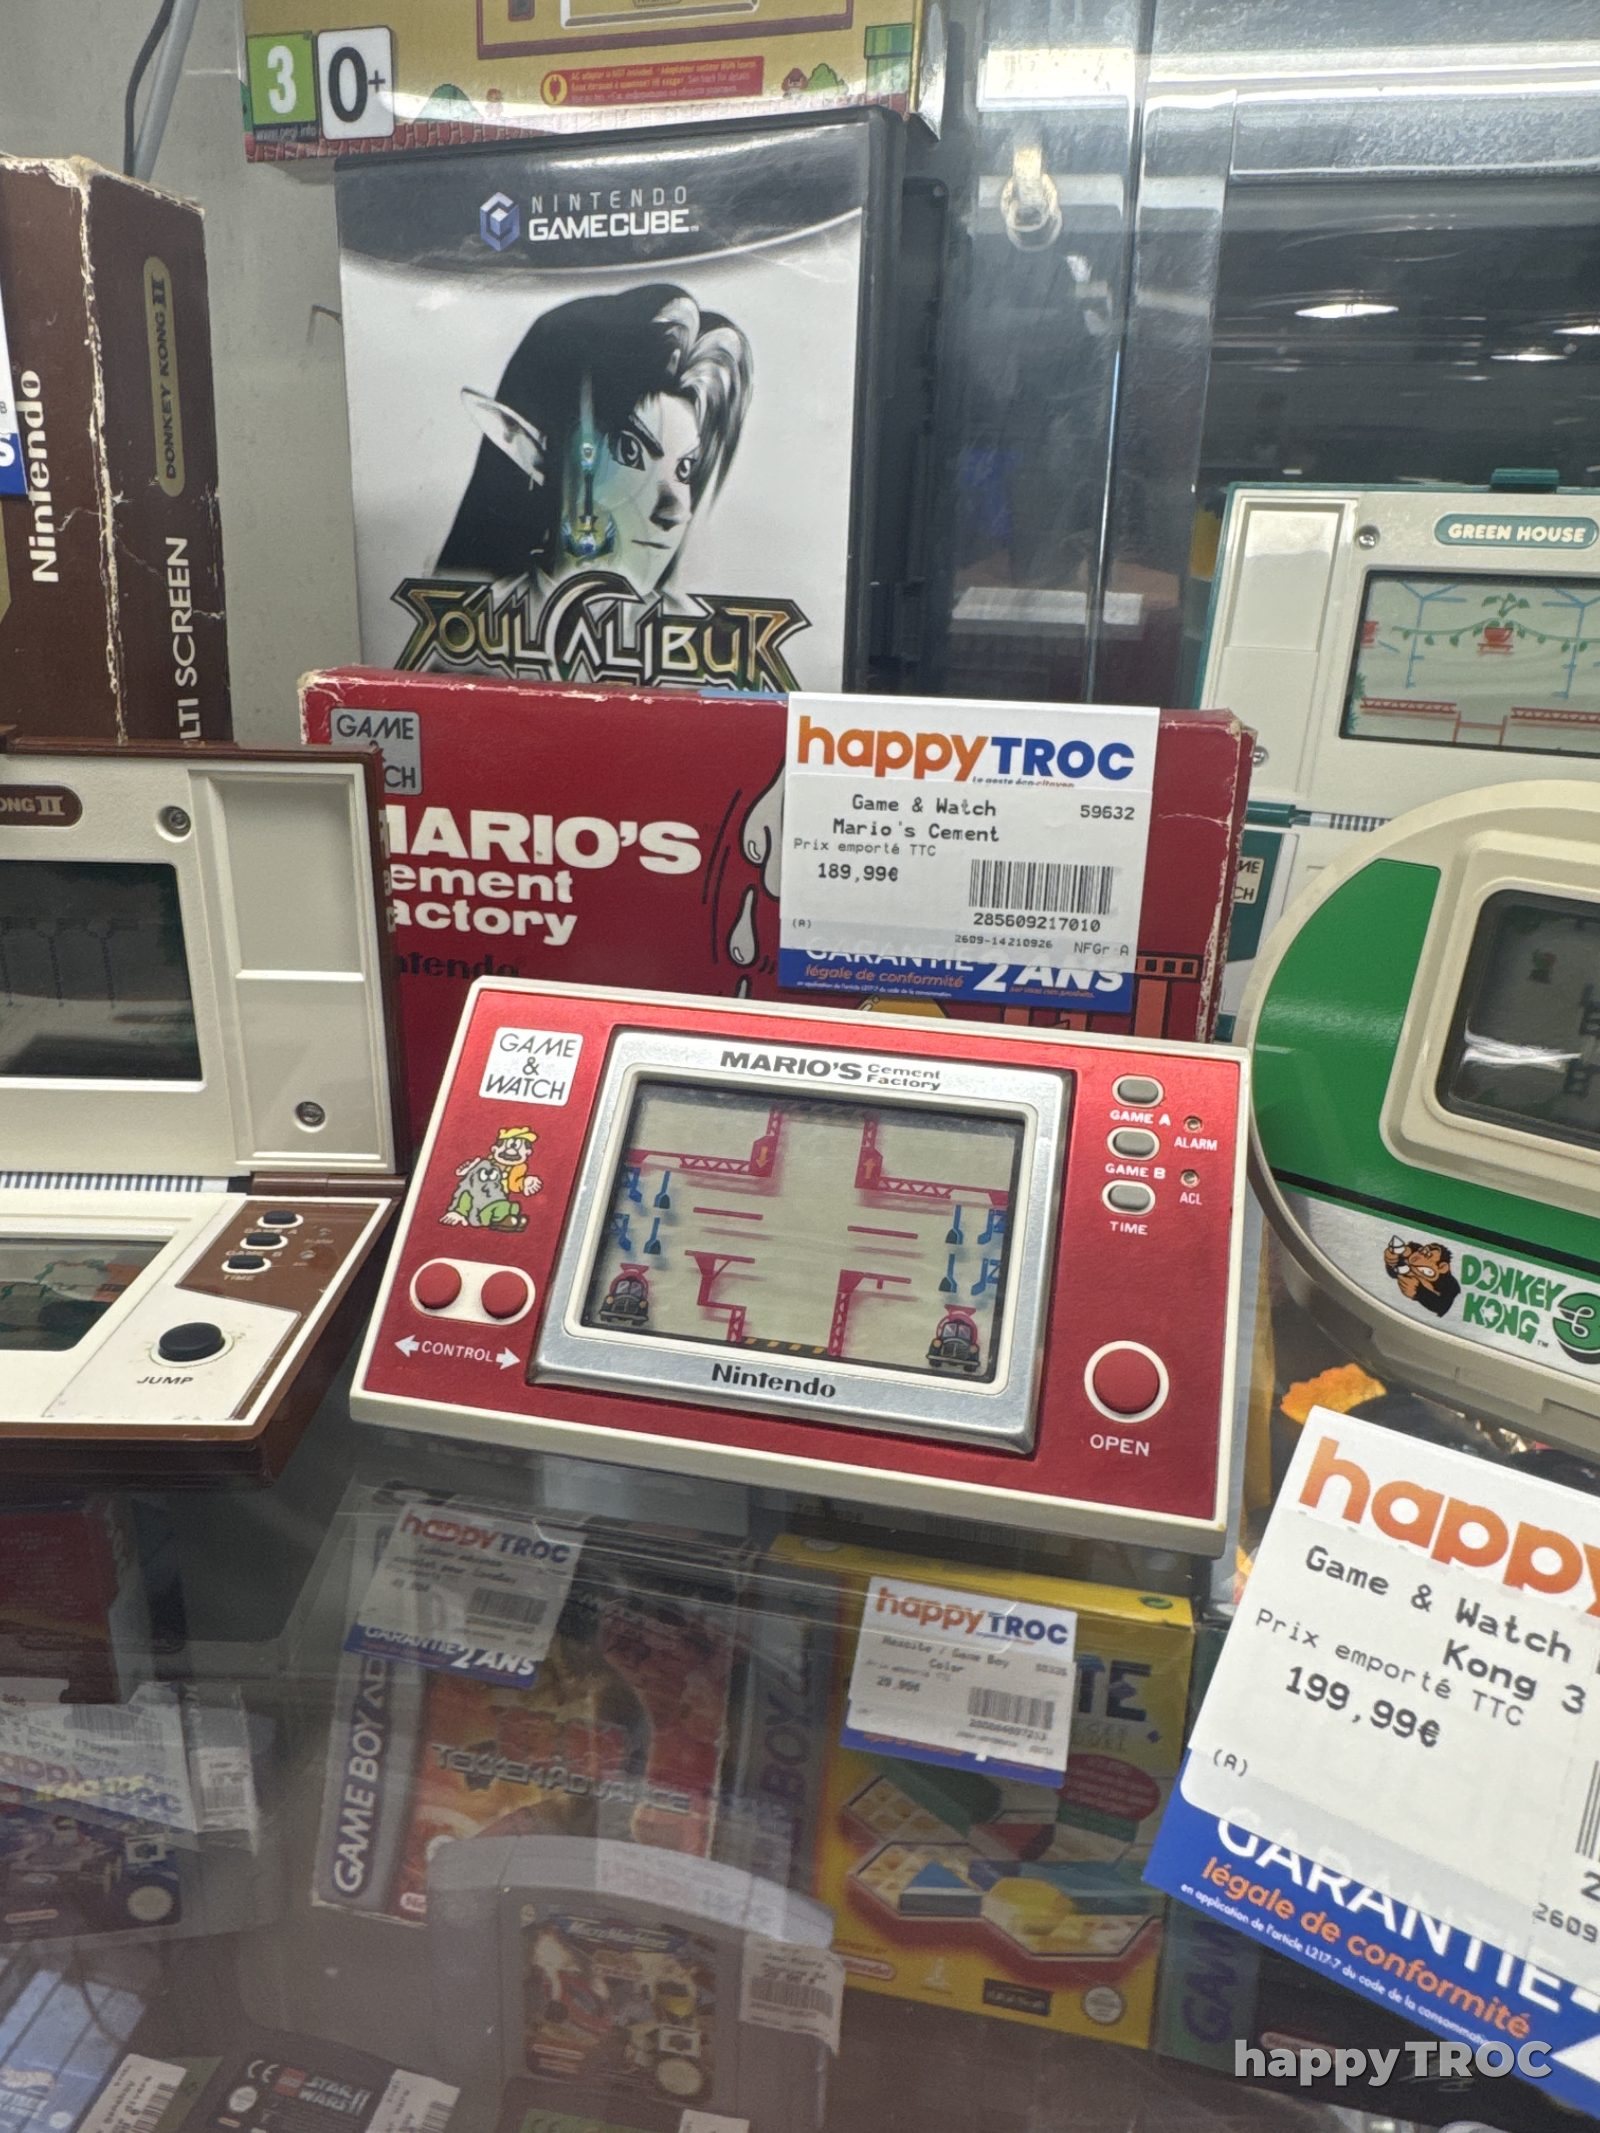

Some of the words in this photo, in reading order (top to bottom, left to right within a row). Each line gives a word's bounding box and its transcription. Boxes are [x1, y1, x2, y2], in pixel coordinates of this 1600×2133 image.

[267, 45, 298, 115] 3
[532, 186, 687, 214] NINTENDO
[529, 209, 690, 242] GAMECUBE
[152, 273, 166, 305] II
[154, 311, 170, 377] KONG
[160, 384, 177, 480] DONKEY
[16, 370, 59, 583] Nintendo
[1447, 523, 1514, 541] GREEN
[1516, 523, 1587, 543] HOUSE
[165, 537, 198, 687] SCREEN
[177, 698, 201, 739] LTI
[337, 714, 414, 740] GAME
[797, 715, 1135, 782] happyTROC
[0, 797, 35, 812] ONG
[35, 796, 66, 816] II
[852, 794, 899, 812] Game
[912, 797, 923, 813] &
[936, 798, 997, 817] Watch
[1080, 804, 1136, 821] 59632
[833, 818, 915, 838] Mario's
[928, 823, 1000, 843] Cement
[793, 838, 829, 851] Prix
[838, 841, 900, 857] emporté
[909, 843, 937, 857] TTC
[389, 863, 574, 904] ement
[817, 863, 899, 883] 189,99€
[392, 899, 578, 946] actory
[973, 912, 1101, 932] 285609217010
[954, 934, 1053, 950] 2609-14210926
[399, 951, 520, 980] tendo
[805, 964, 853, 981] légale
[855, 968, 875, 982] de
[878, 969, 965, 989] conformité
[499, 1032, 577, 1058] GAME
[522, 1057, 540, 1076] &
[719, 1051, 863, 1081] MARIO'S
[867, 1064, 941, 1081] Cement
[484, 1075, 566, 1101] WATCH
[866, 1074, 942, 1092] Factory
[1109, 1109, 1154, 1124] GAME
[1158, 1112, 1171, 1127] A
[1173, 1136, 1218, 1152] ALARM
[1105, 1162, 1149, 1178] GAME
[1153, 1166, 1166, 1180] B
[1179, 1191, 1203, 1206] ACL
[1109, 1220, 1149, 1236] TIME
[1461, 1254, 1567, 1312] DONKEY
[1463, 1292, 1541, 1345] KONG
[1553, 1292, 1600, 1358] 3
[421, 1339, 494, 1364] CONTROL
[137, 1375, 195, 1386] JUMP
[711, 1363, 837, 1399] Nintendo
[1089, 1433, 1151, 1458] OPEN
[1298, 1436, 1600, 1618] happ
[875, 1586, 1069, 1645] happyTROC
[1305, 1544, 1390, 1597] Game
[1410, 1584, 1433, 1612] &
[1455, 1597, 1572, 1663] Watch
[1254, 1607, 1320, 1649] Prix
[1334, 1642, 1451, 1700] emporté
[1471, 1689, 1526, 1728] TTC
[1442, 1639, 1537, 1702] Kong
[1560, 1684, 1587, 1715] 3
[1285, 1665, 1442, 1749] 199,99€
[350, 1714, 386, 1781] BOY
[1212, 1748, 1249, 1778] (A)
[333, 1787, 375, 1894] GAME
[1201, 1856, 1295, 1919] légale
[1301, 1906, 1341, 1944] de
[1345, 1932, 1533, 2040] conformité
[1181, 1883, 1194, 1896] en
[1196, 1886, 1250, 1925] application
[1251, 1916, 1265, 1932] de
[1265, 1921, 1304, 1954] l'article
[1342, 1963, 1357, 1980] du
[1358, 1970, 1386, 1995] code
[1388, 1986, 1403, 2005] de
[1404, 1993, 1417, 2011] la
[1417, 2004, 1492, 2046] consommati
